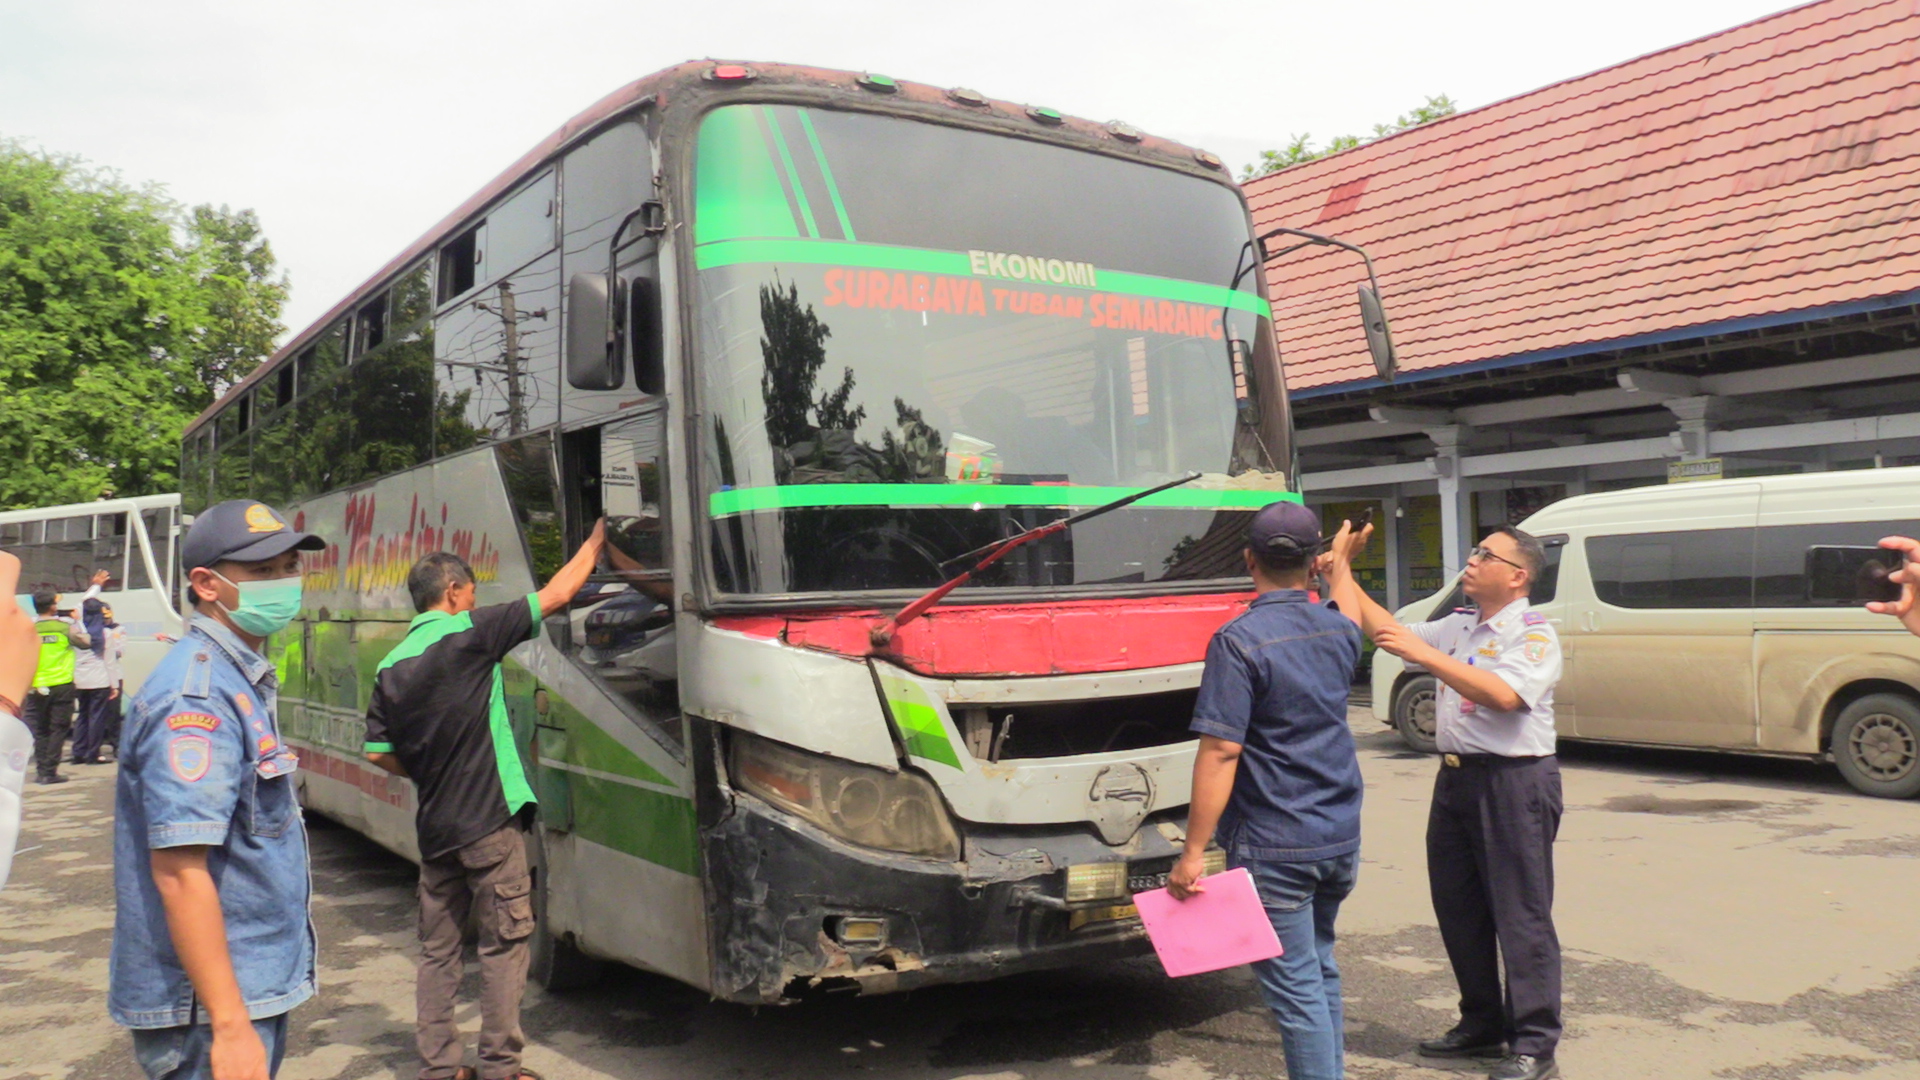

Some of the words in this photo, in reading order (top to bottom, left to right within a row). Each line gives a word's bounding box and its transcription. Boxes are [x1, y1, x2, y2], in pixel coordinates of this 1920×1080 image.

[968, 249, 1096, 287] EKONOMI
[822, 268, 986, 317] SURABAYA
[991, 288, 1084, 318] TUBAN
[1089, 293, 1223, 340] SEMARANG
